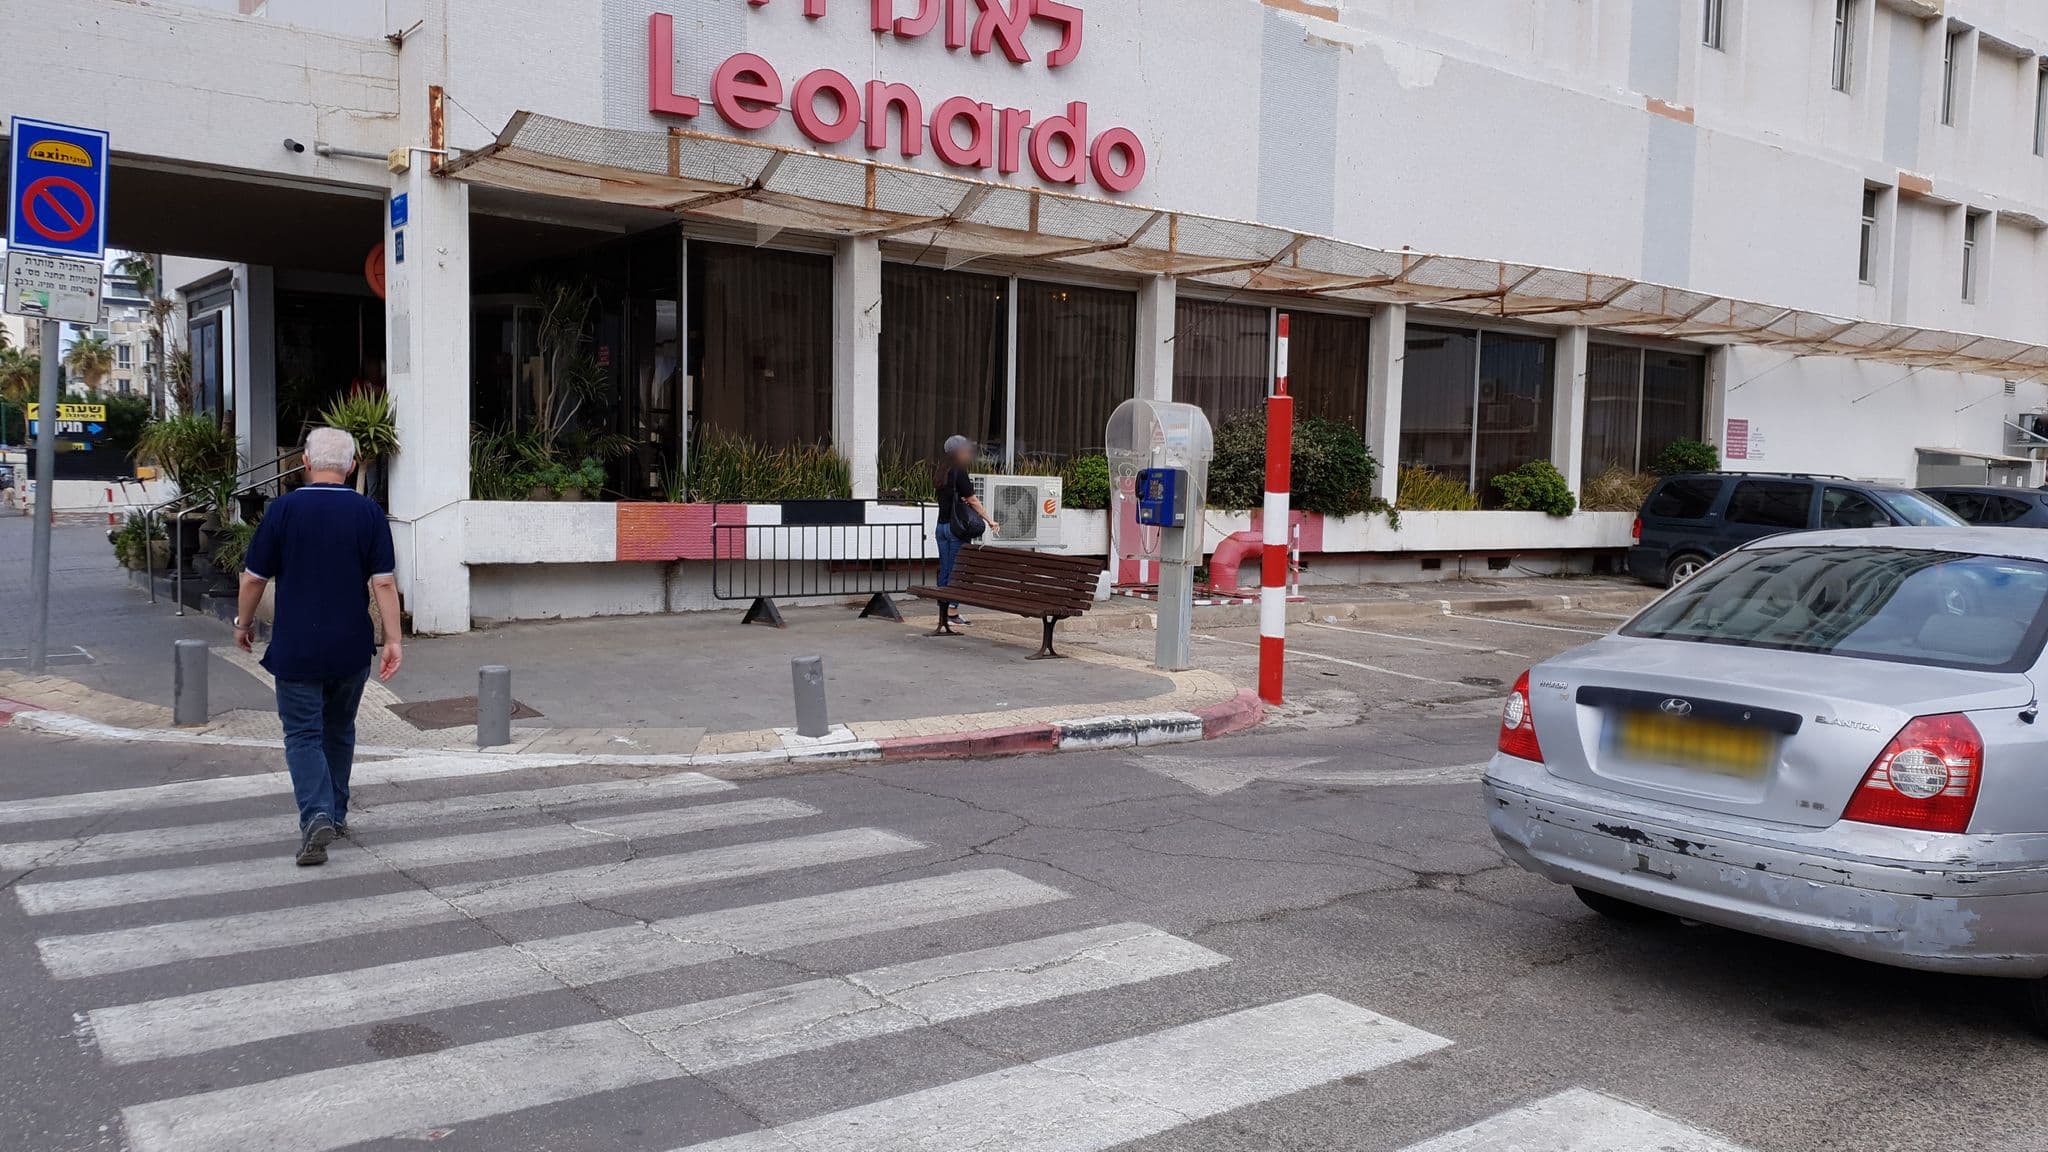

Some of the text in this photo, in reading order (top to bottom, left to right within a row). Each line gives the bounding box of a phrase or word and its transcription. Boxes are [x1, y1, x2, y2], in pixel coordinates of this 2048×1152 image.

[748, 0, 1084, 69] לאונ
[648, 12, 1147, 193] Leonardo
[60, 153, 87, 164] מונית
[25, 257, 86, 273] החניה מותרת
[14, 267, 22, 276] 4
[43, 271, 66, 280] תחנה
[69, 273, 98, 285] למוניות
[65, 405, 102, 414] שעה
[1814, 715, 1881, 734] ELANTRA
